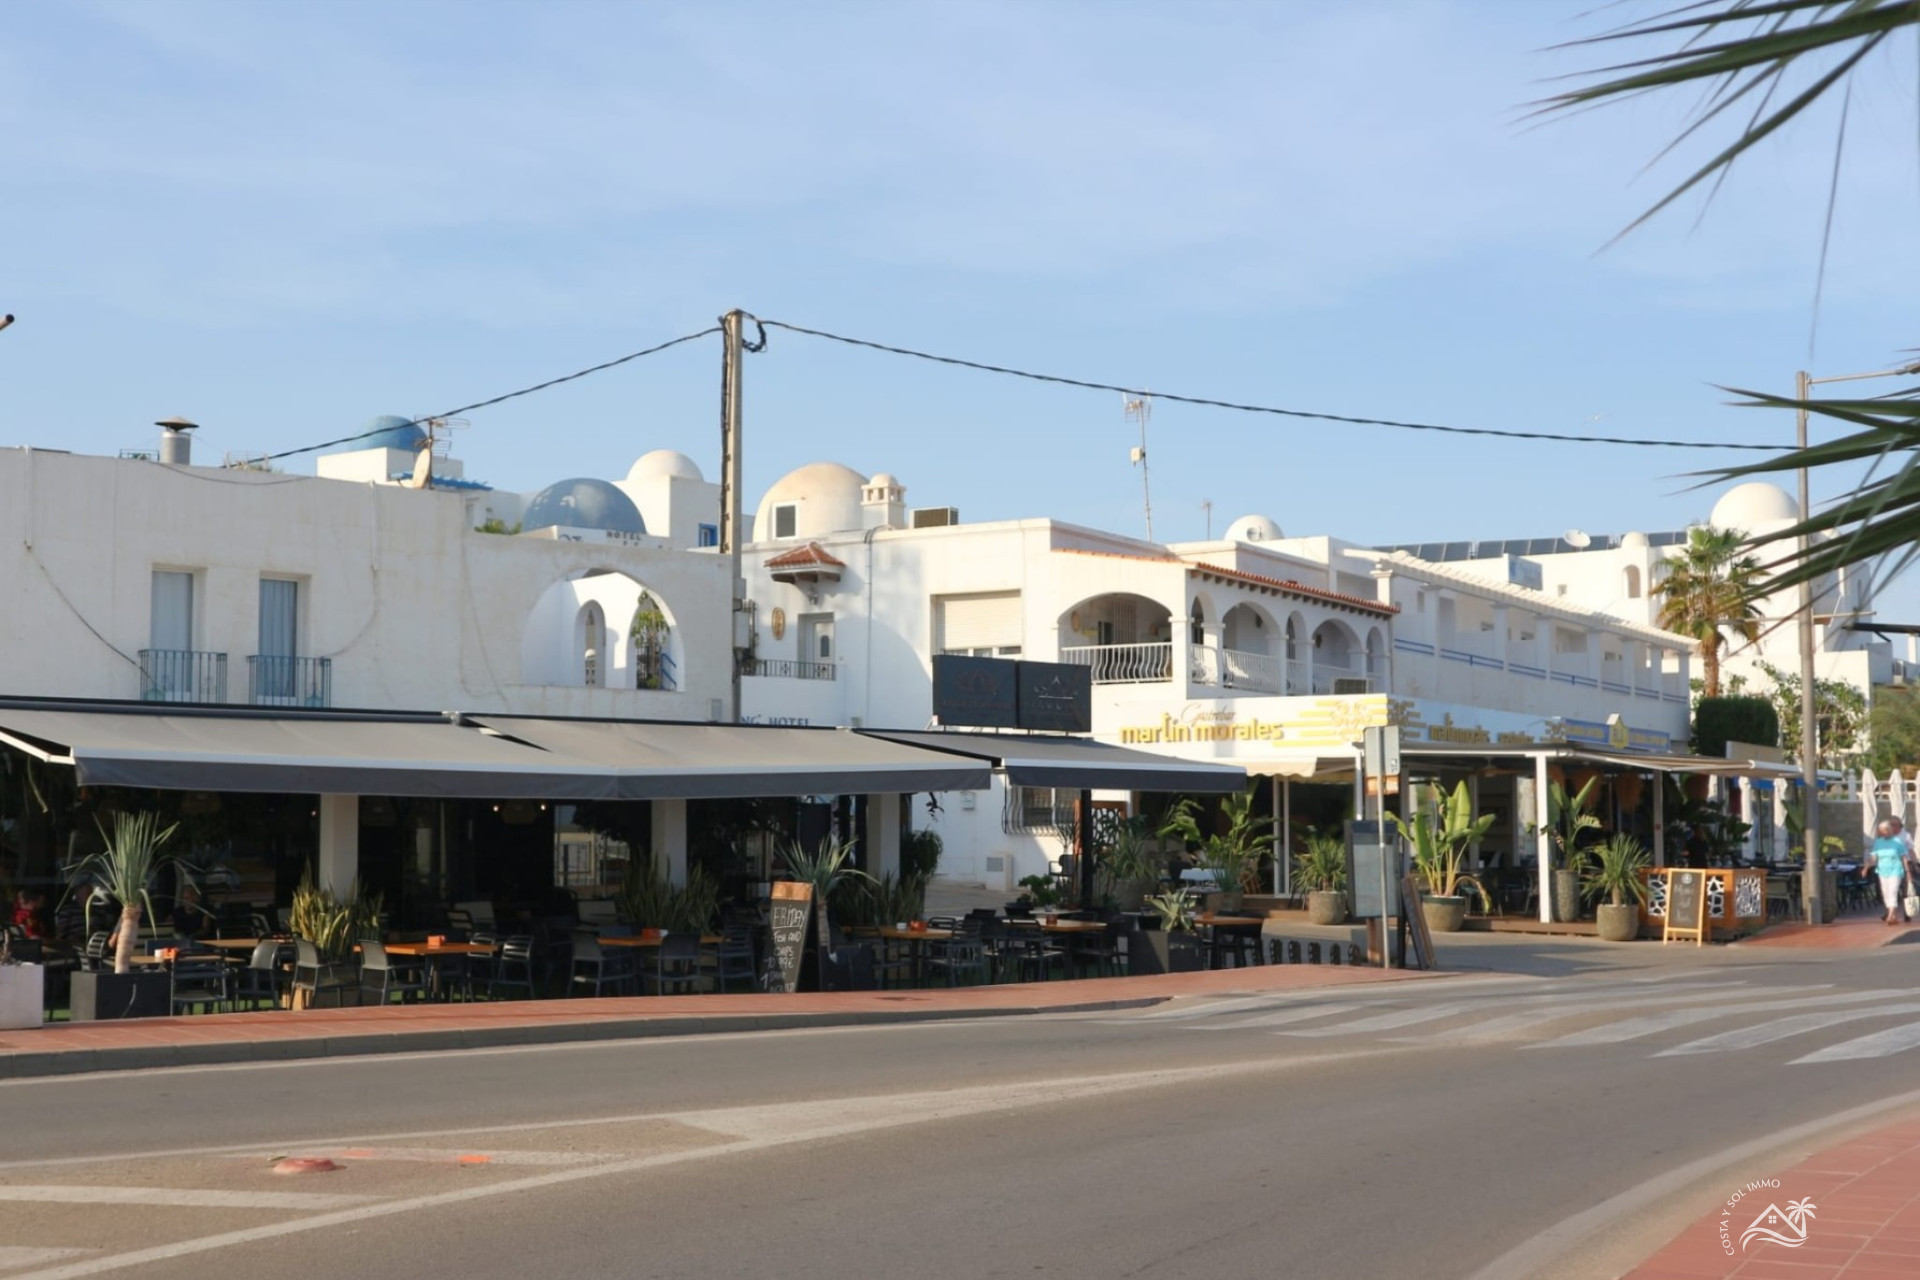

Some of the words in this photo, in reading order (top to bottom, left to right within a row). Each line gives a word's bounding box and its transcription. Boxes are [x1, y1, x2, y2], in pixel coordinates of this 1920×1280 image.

[607, 531, 641, 541] HOTEL
[769, 717, 809, 726] HOTEL
[1119, 712, 1190, 743] martin
[1193, 718, 1284, 742] morales
